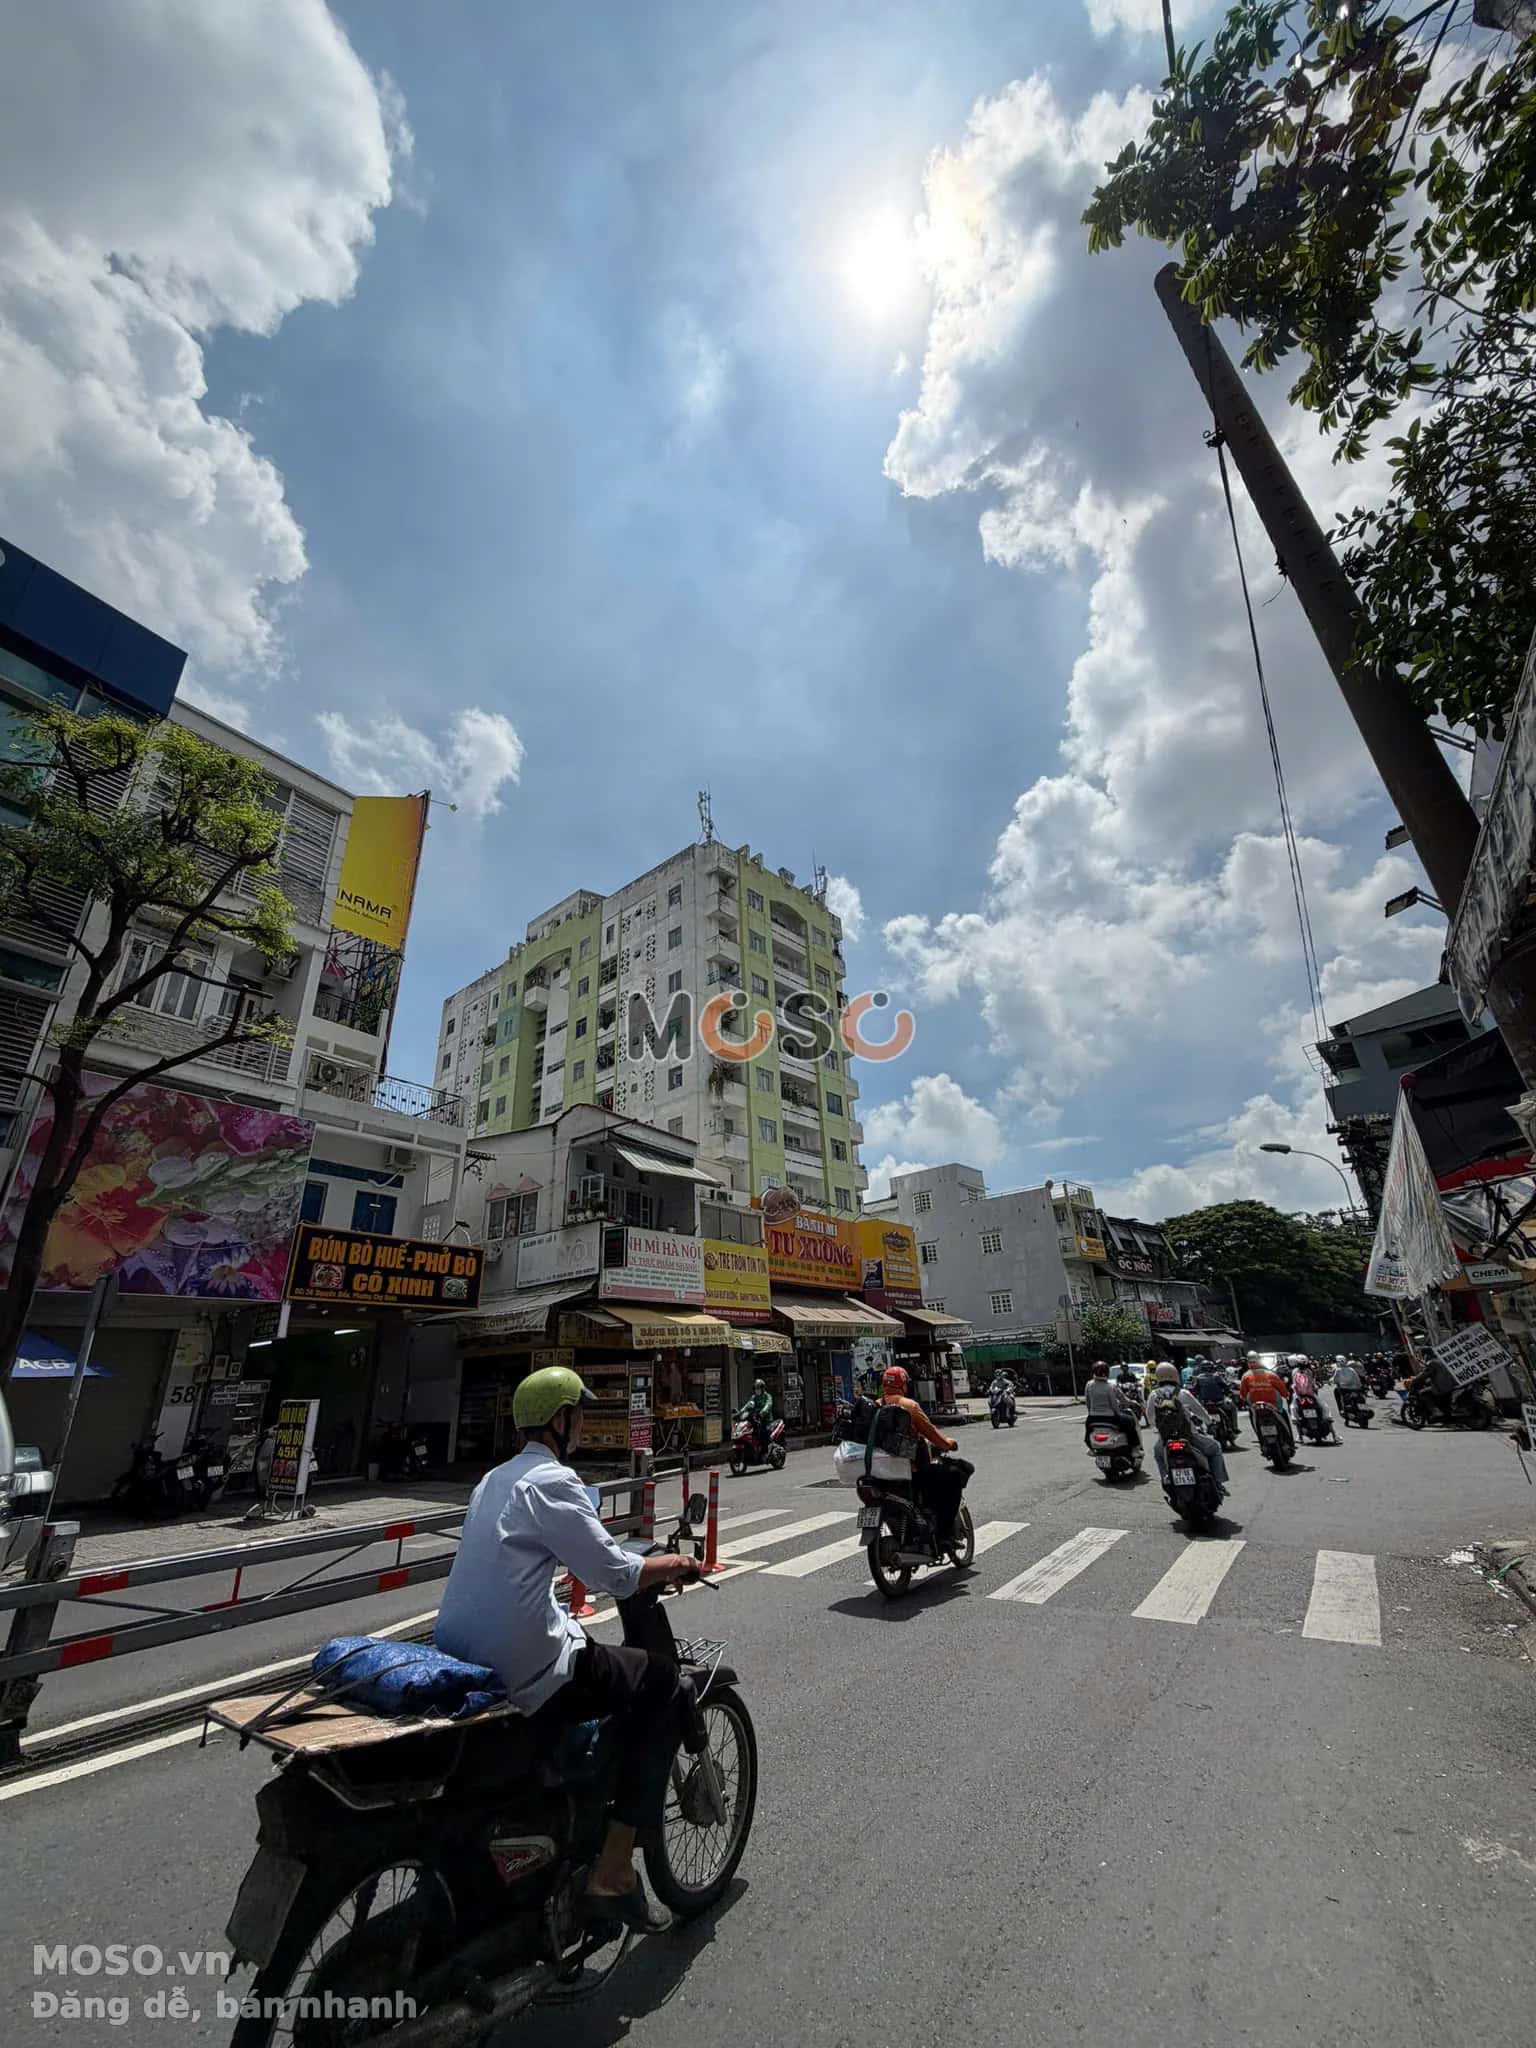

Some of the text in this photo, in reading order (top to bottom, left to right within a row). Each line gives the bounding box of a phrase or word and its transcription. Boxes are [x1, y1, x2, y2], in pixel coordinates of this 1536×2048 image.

[308, 1234, 347, 1263] BÚN
[348, 1239, 373, 1266] BÒ
[452, 1251, 477, 1277] BÒ
[645, 1235, 660, 1255] MÌ
[662, 1238, 680, 1257] HÀ
[352, 1270, 436, 1297] CÔ XINH
[19, 1358, 71, 1370] ACB
[170, 1386, 196, 1404] 58
